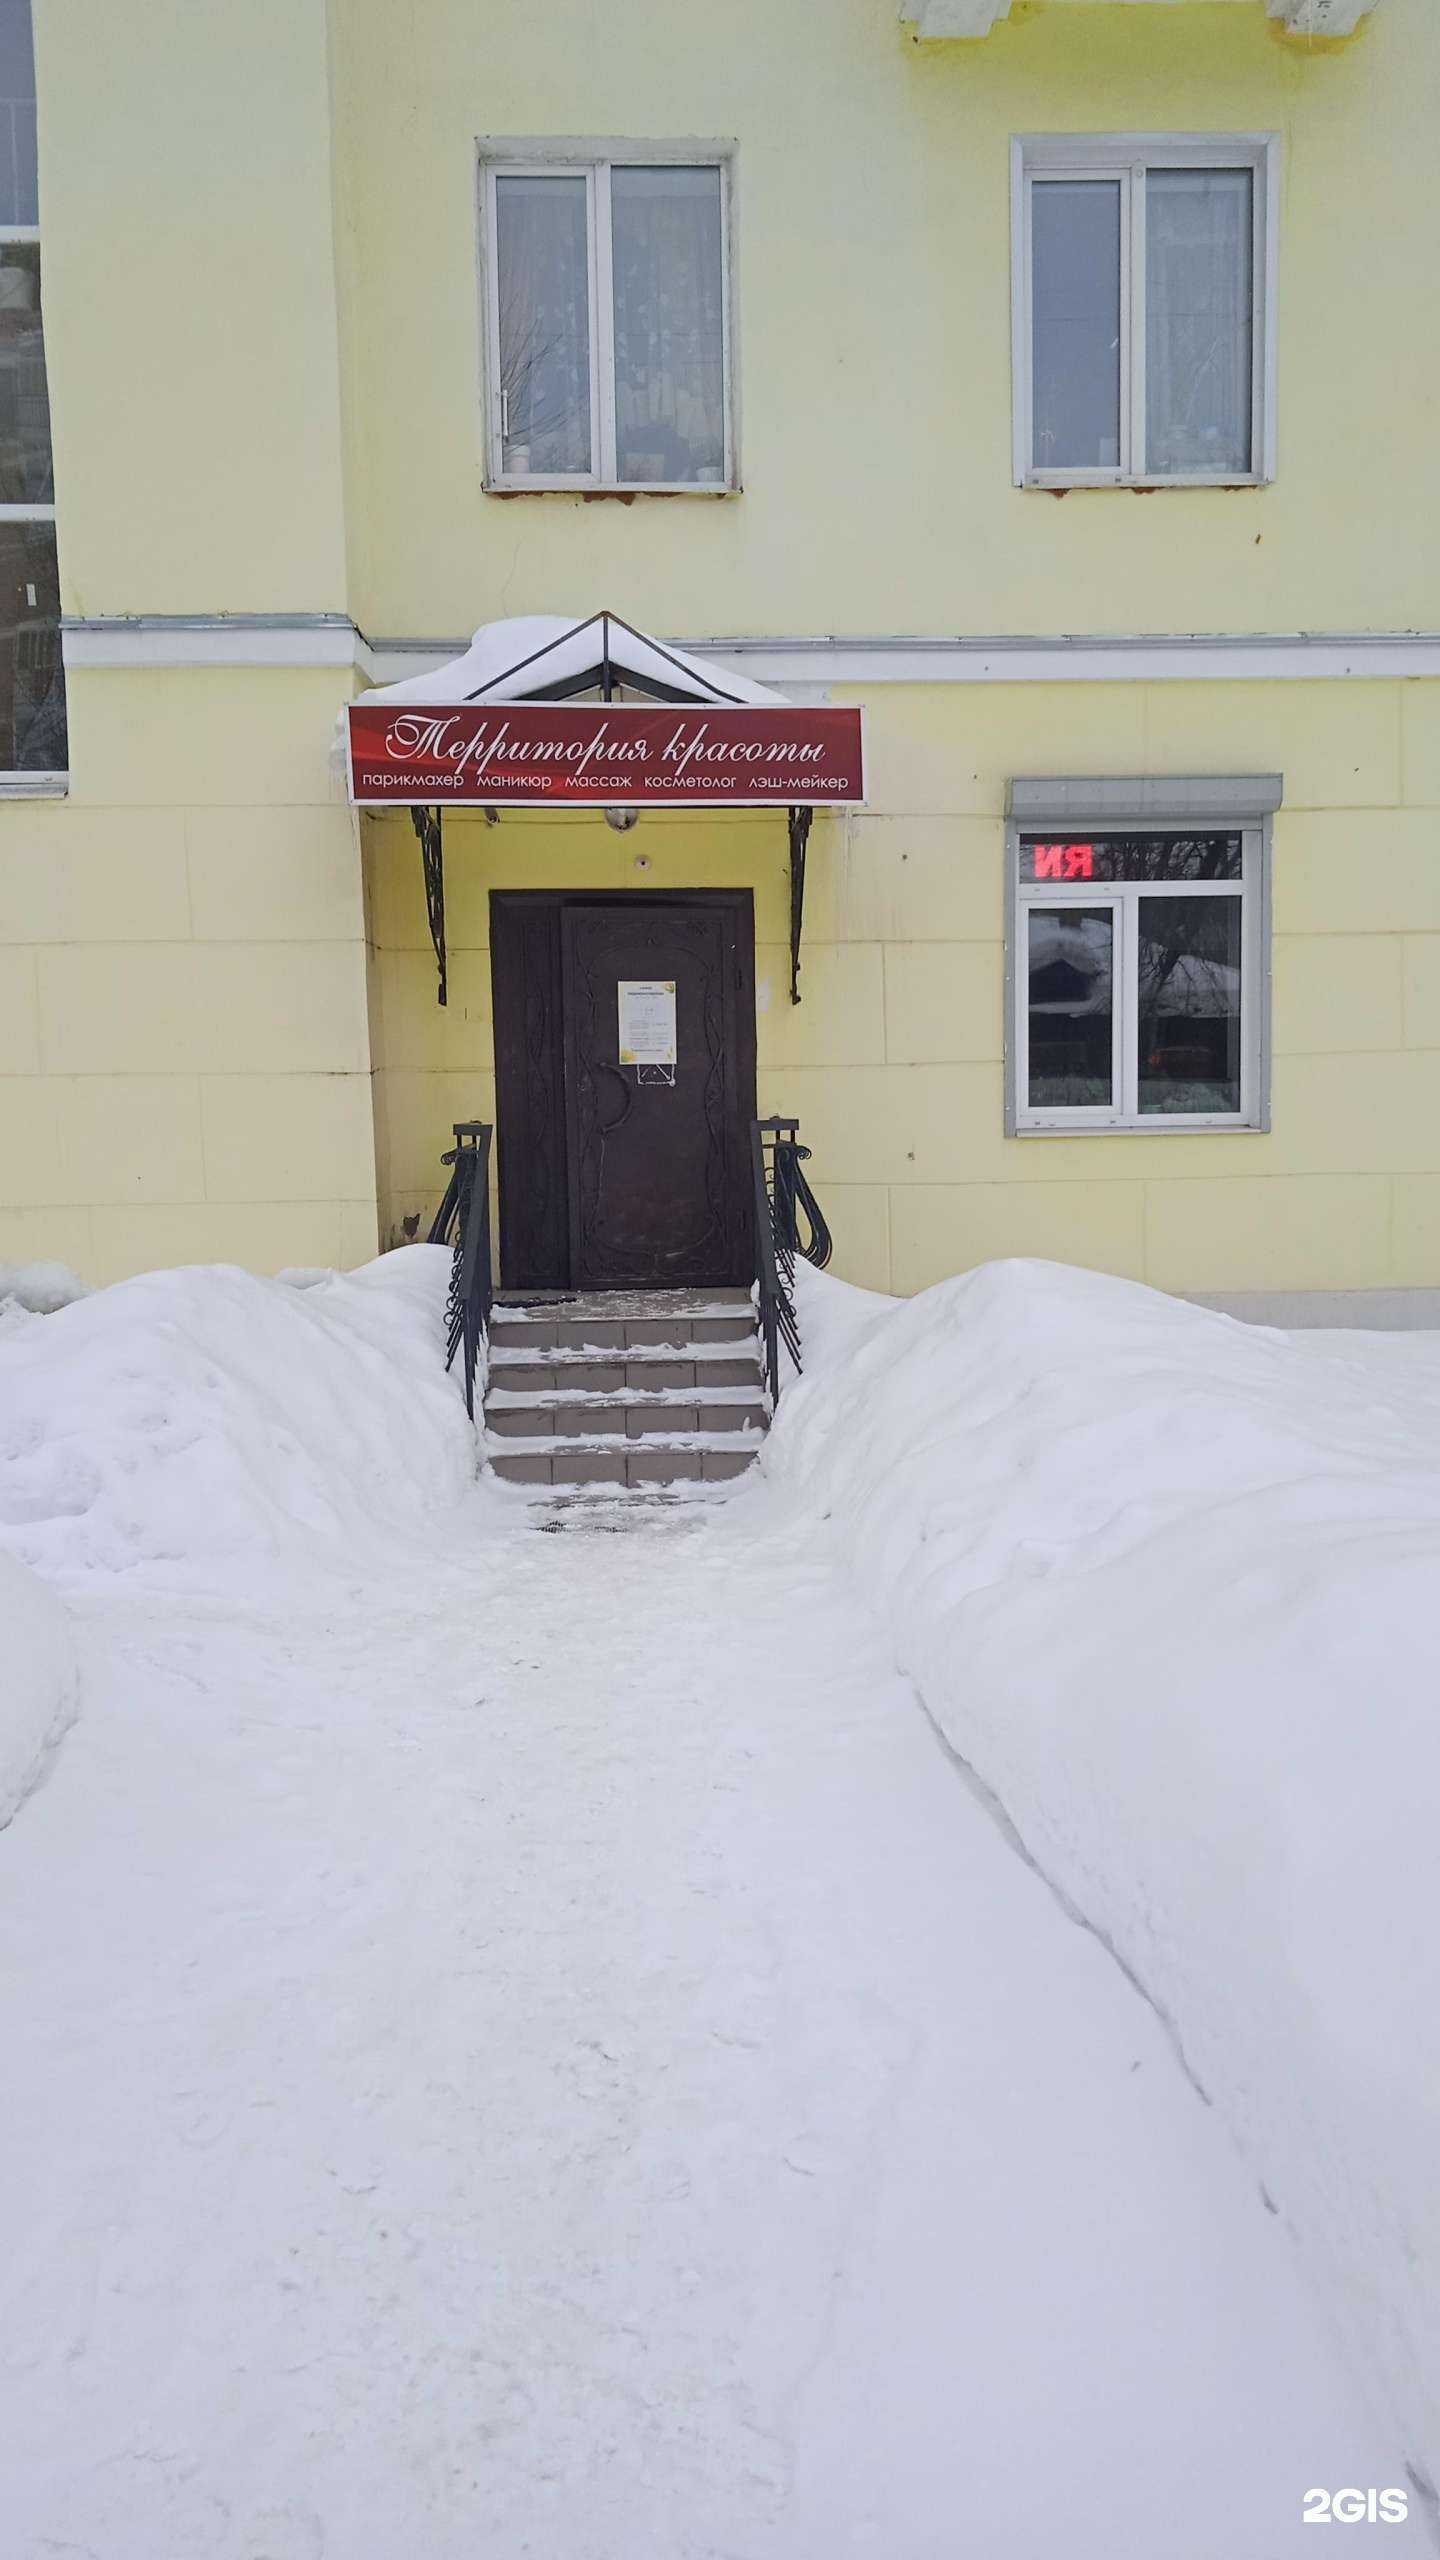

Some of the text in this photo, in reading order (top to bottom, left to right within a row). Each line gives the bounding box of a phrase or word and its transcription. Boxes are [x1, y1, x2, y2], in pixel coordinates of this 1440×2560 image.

[385, 714, 826, 777] Территория красоты
[362, 774, 849, 791] парикмахер маникюр массаж косметолог лэш-мейкер
[1034, 844, 1092, 879] ИЯ
